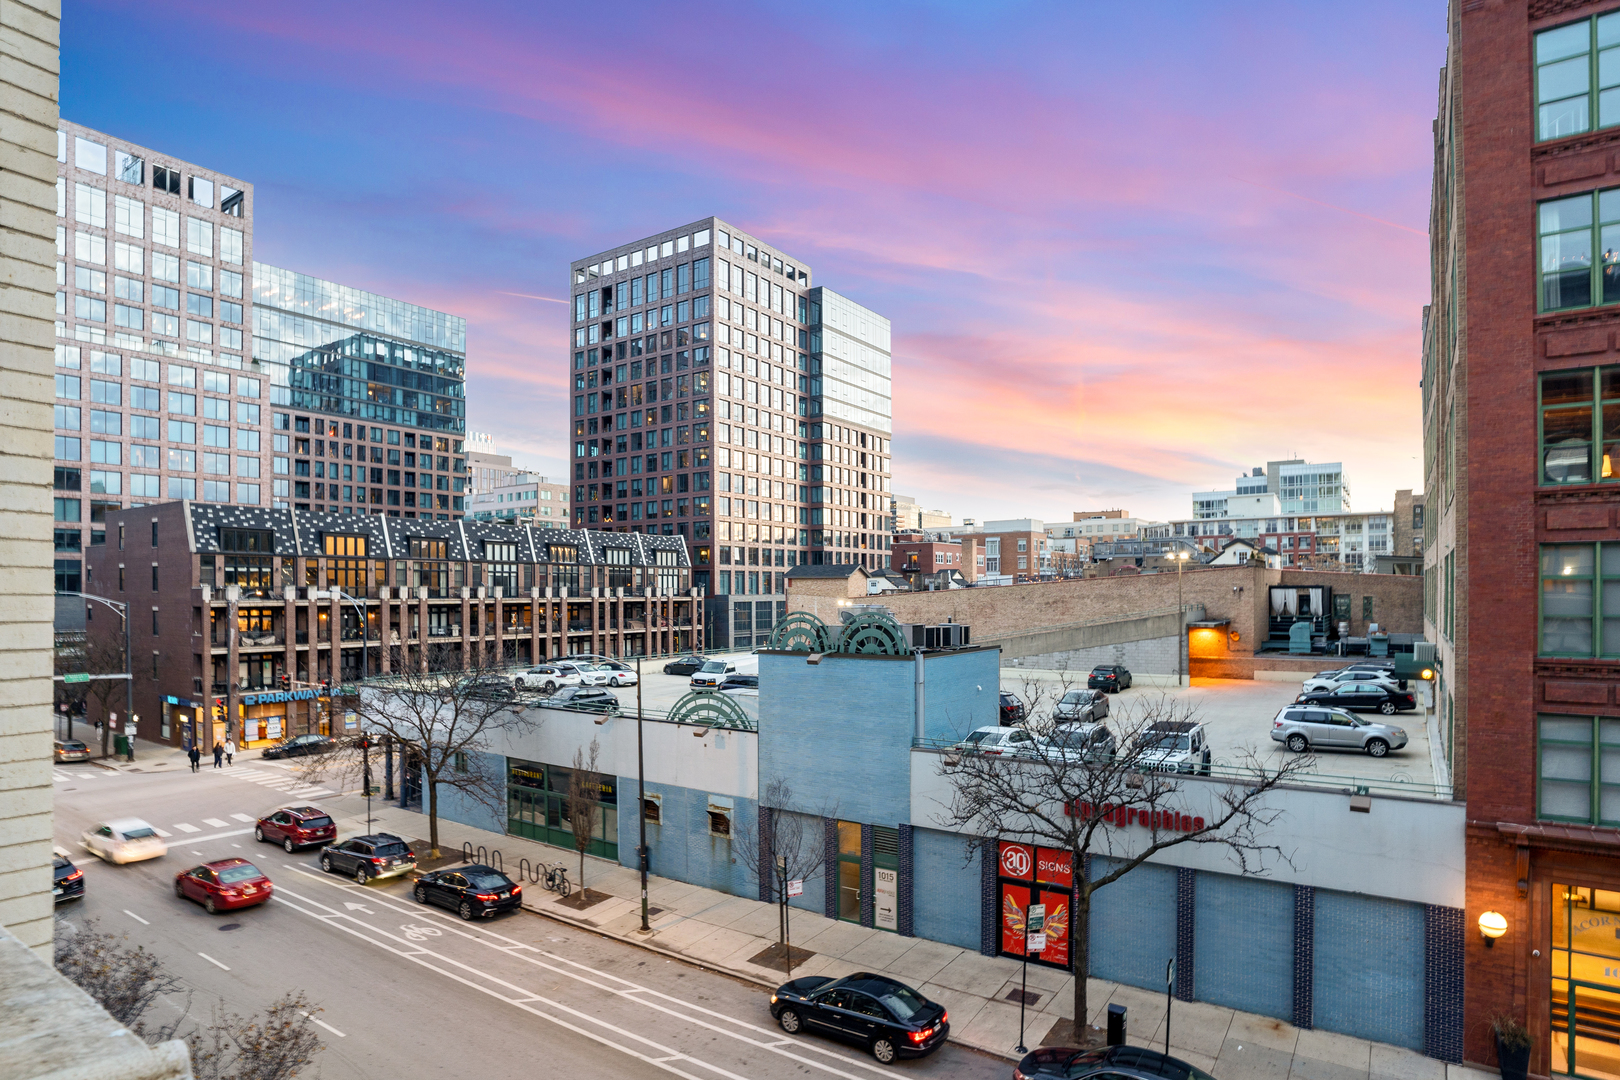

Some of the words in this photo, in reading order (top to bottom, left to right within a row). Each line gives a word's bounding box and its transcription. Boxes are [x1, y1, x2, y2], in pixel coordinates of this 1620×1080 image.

[258, 689, 321, 704] PARKWAY
[511, 768, 543, 780] RESTAURANT
[1038, 860, 1070, 874] SIGNS
[878, 871, 894, 881] 1015
